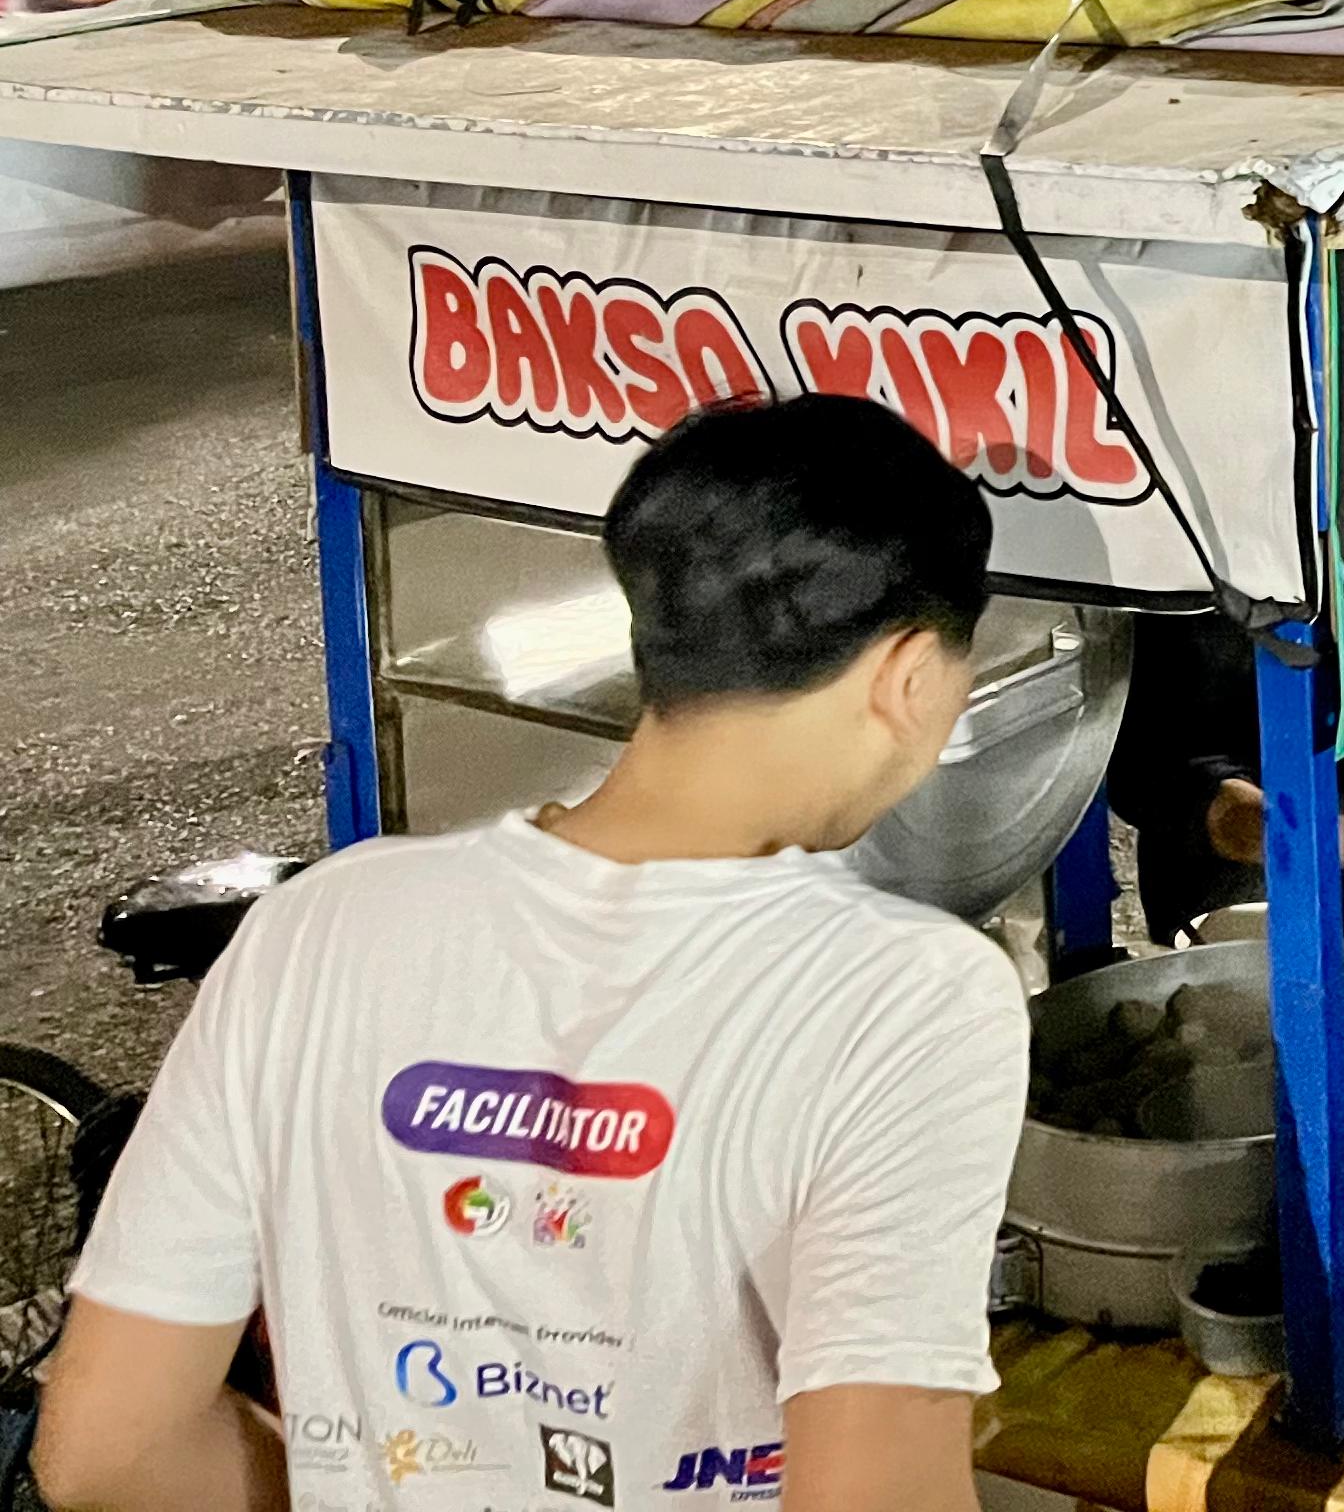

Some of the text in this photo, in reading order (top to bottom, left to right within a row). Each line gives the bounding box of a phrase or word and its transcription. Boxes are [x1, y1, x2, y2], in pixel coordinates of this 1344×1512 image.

[408, 245, 774, 448] BAKSO
[410, 1084, 649, 1153] FACILITATOR
[476, 1361, 612, 1419] Biznet
[662, 1442, 785, 1491] JNE
